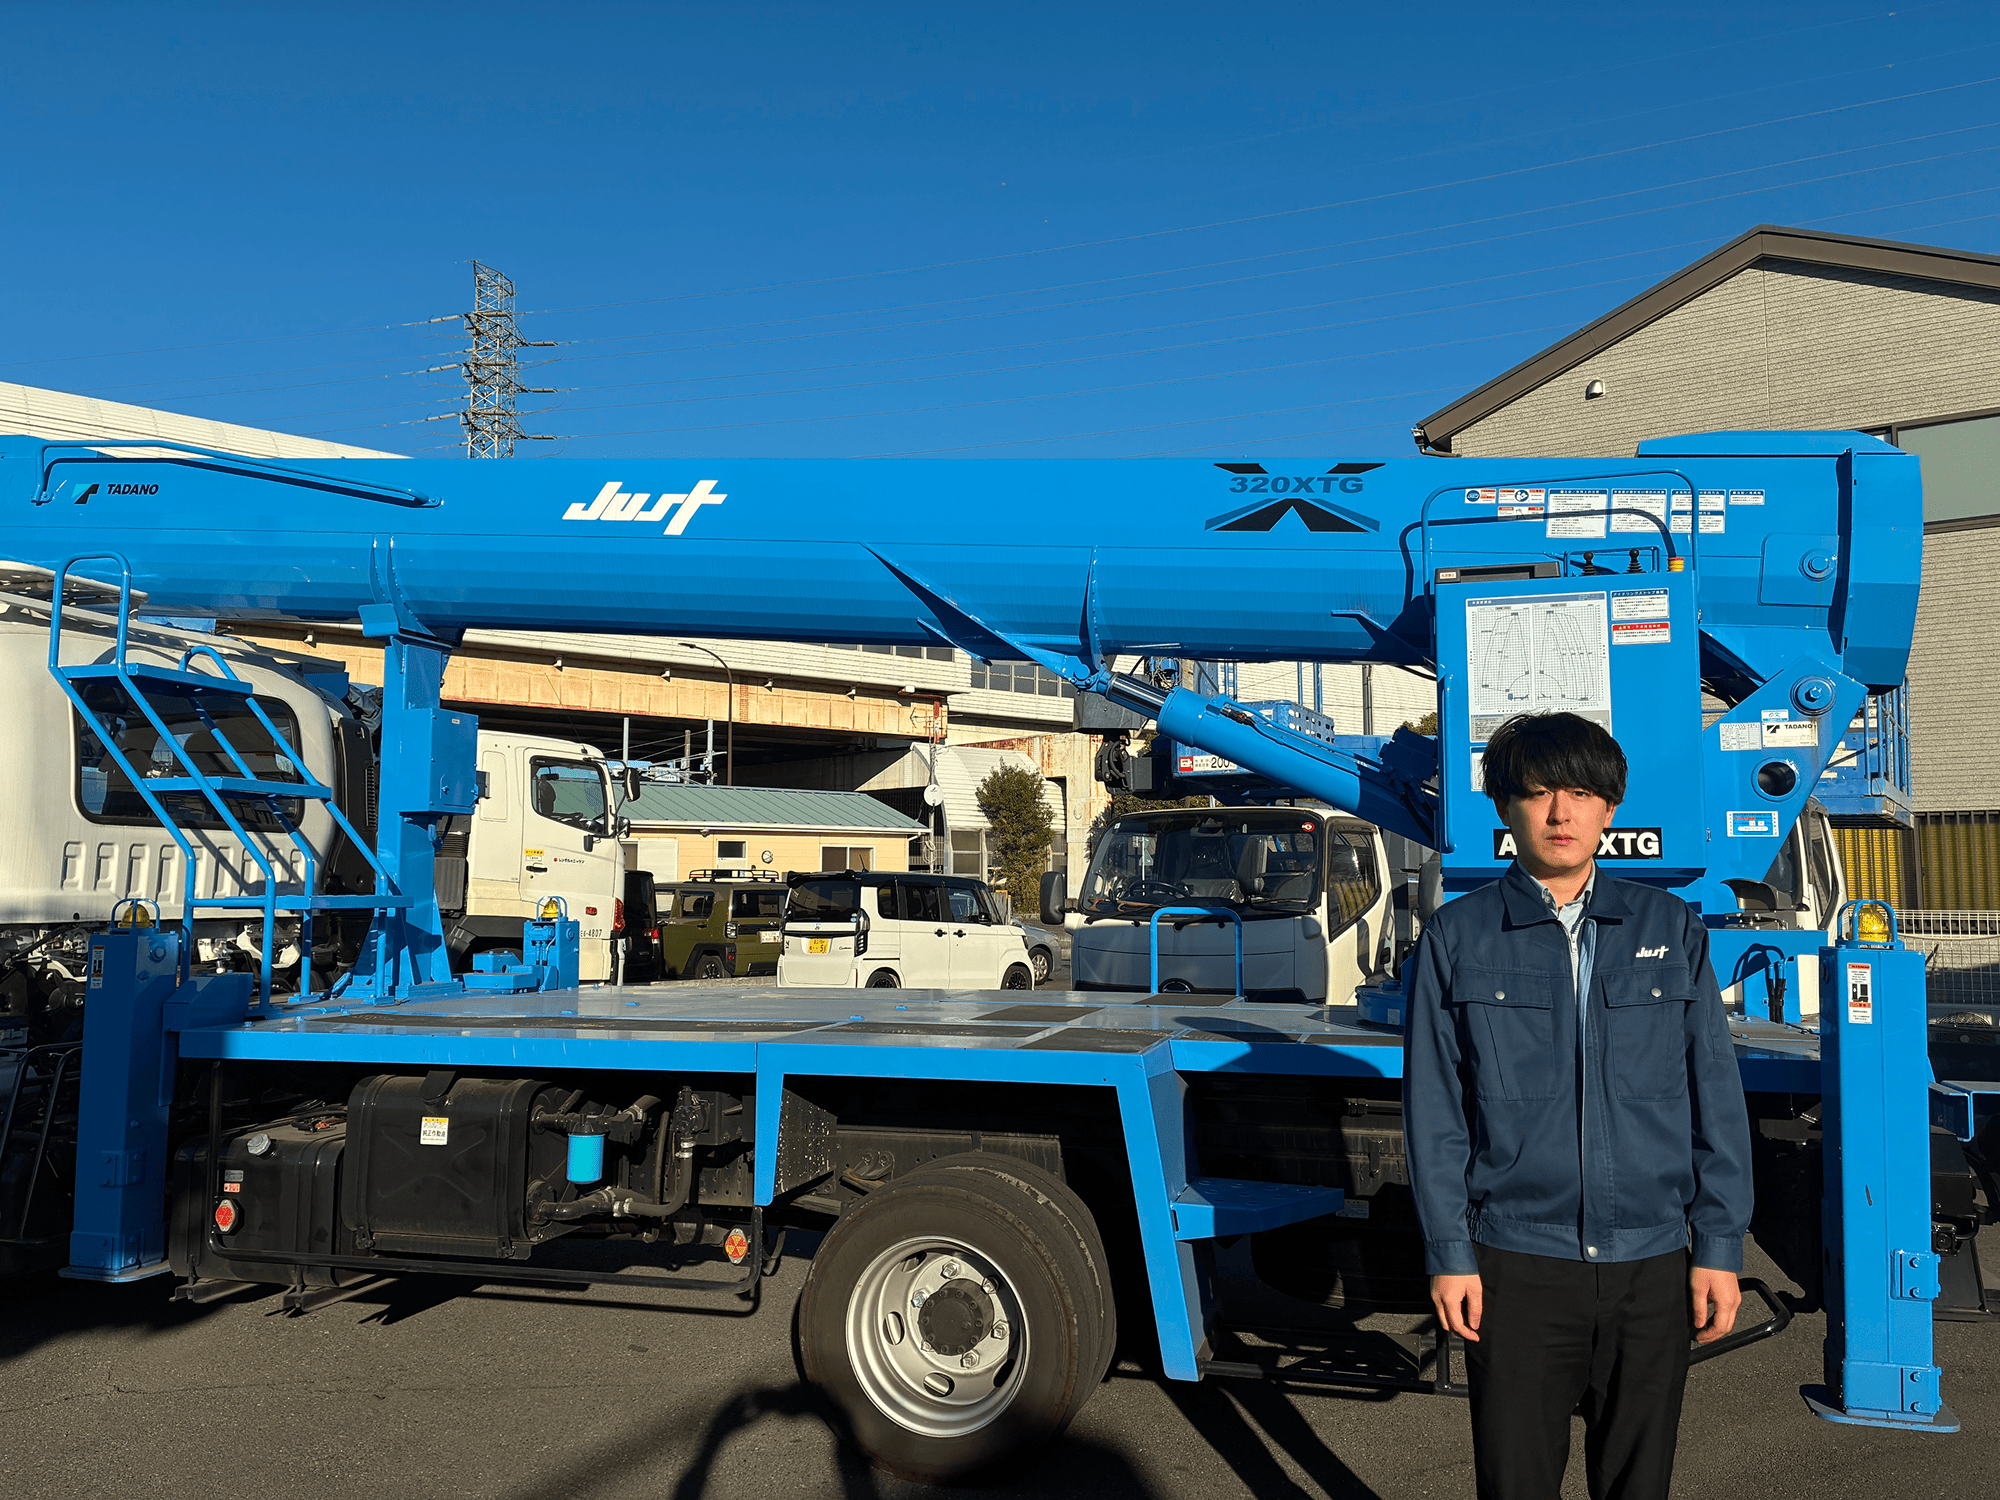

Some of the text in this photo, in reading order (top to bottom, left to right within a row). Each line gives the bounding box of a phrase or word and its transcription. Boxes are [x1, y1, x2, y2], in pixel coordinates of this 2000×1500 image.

[107, 484, 159, 495] TADANO
[1229, 476, 1364, 493] 320XTG
[562, 480, 728, 536] Just
[1211, 757, 1230, 769] 200
[1635, 945, 1669, 959] Just
